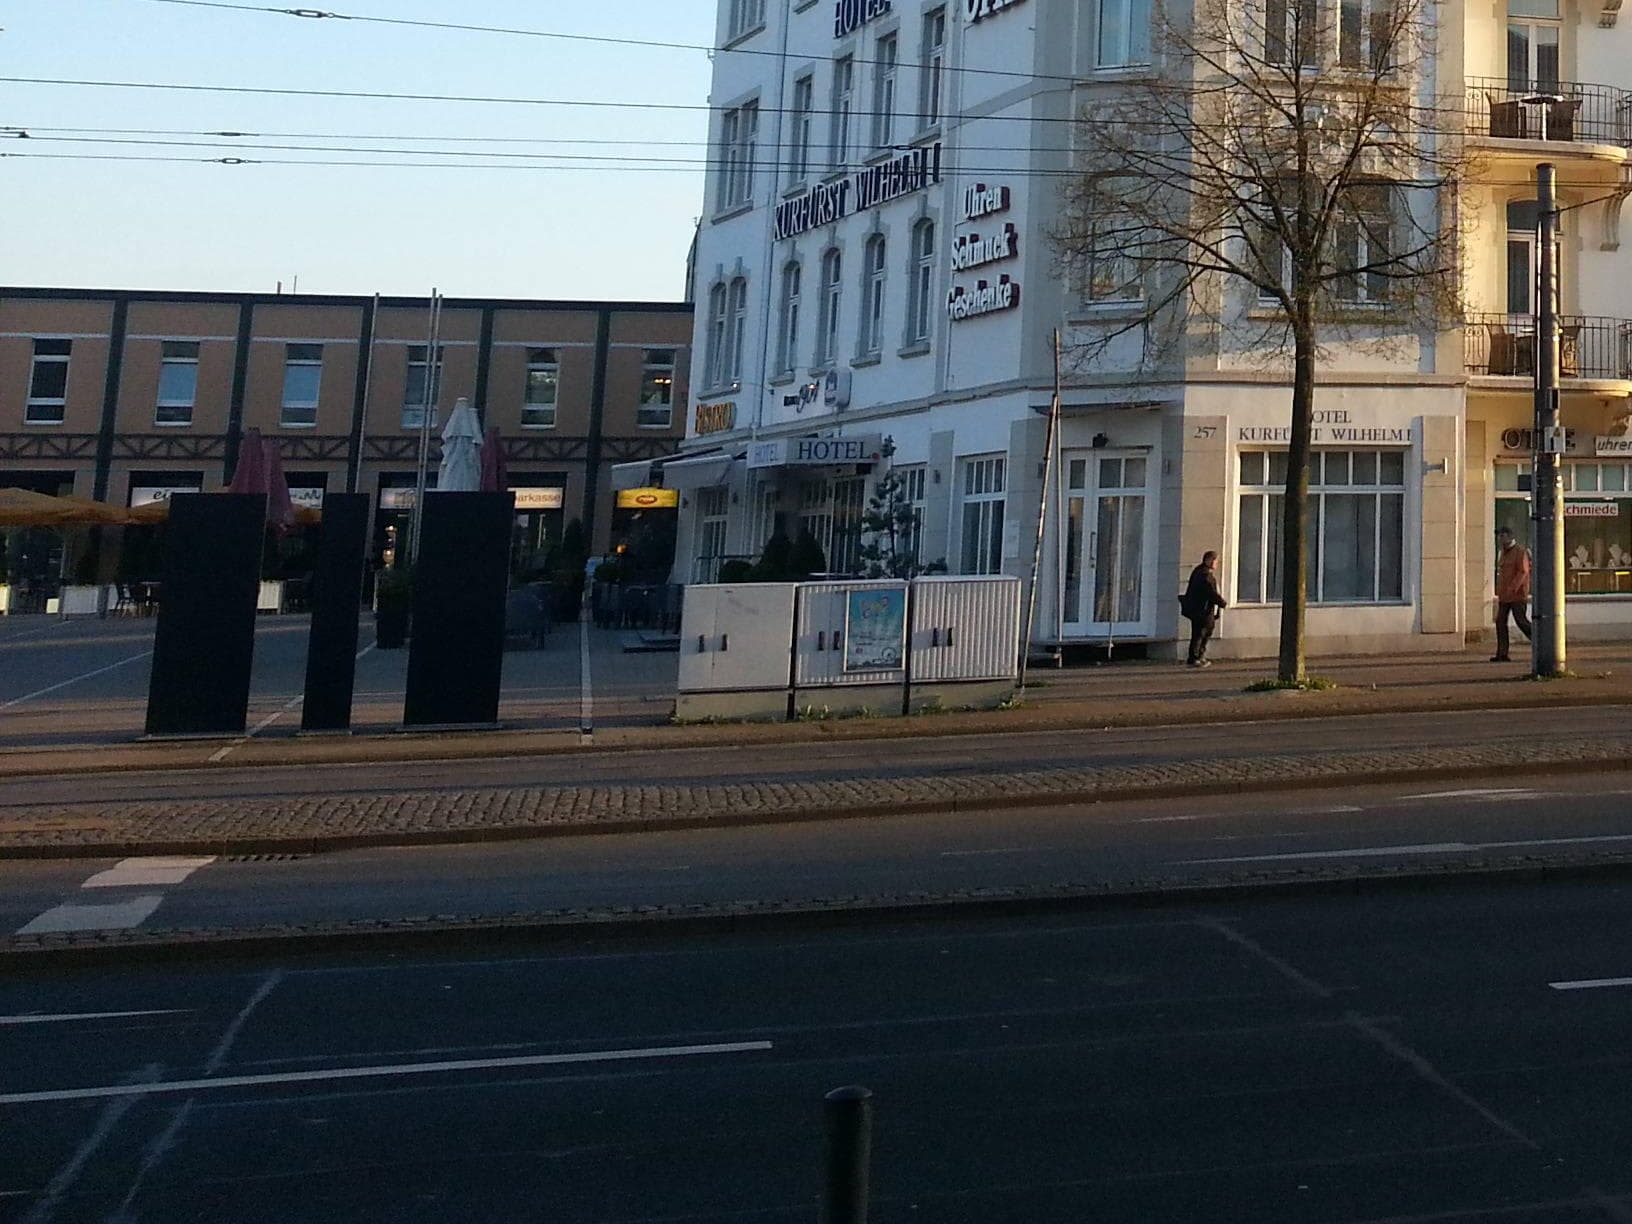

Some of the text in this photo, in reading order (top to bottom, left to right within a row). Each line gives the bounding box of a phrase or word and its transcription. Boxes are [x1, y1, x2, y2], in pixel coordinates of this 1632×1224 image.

[855, 147, 930, 212] WILHELM
[964, 183, 1010, 220] Uhren
[951, 223, 1018, 271] Schmuck
[946, 274, 1020, 320] Geschenke
[695, 402, 736, 435] BISTRO
[1194, 427, 1217, 438] 257
[1312, 410, 1352, 423] OTEL
[799, 440, 871, 460] HOTEL
[1331, 428, 1402, 441] WILHELM
